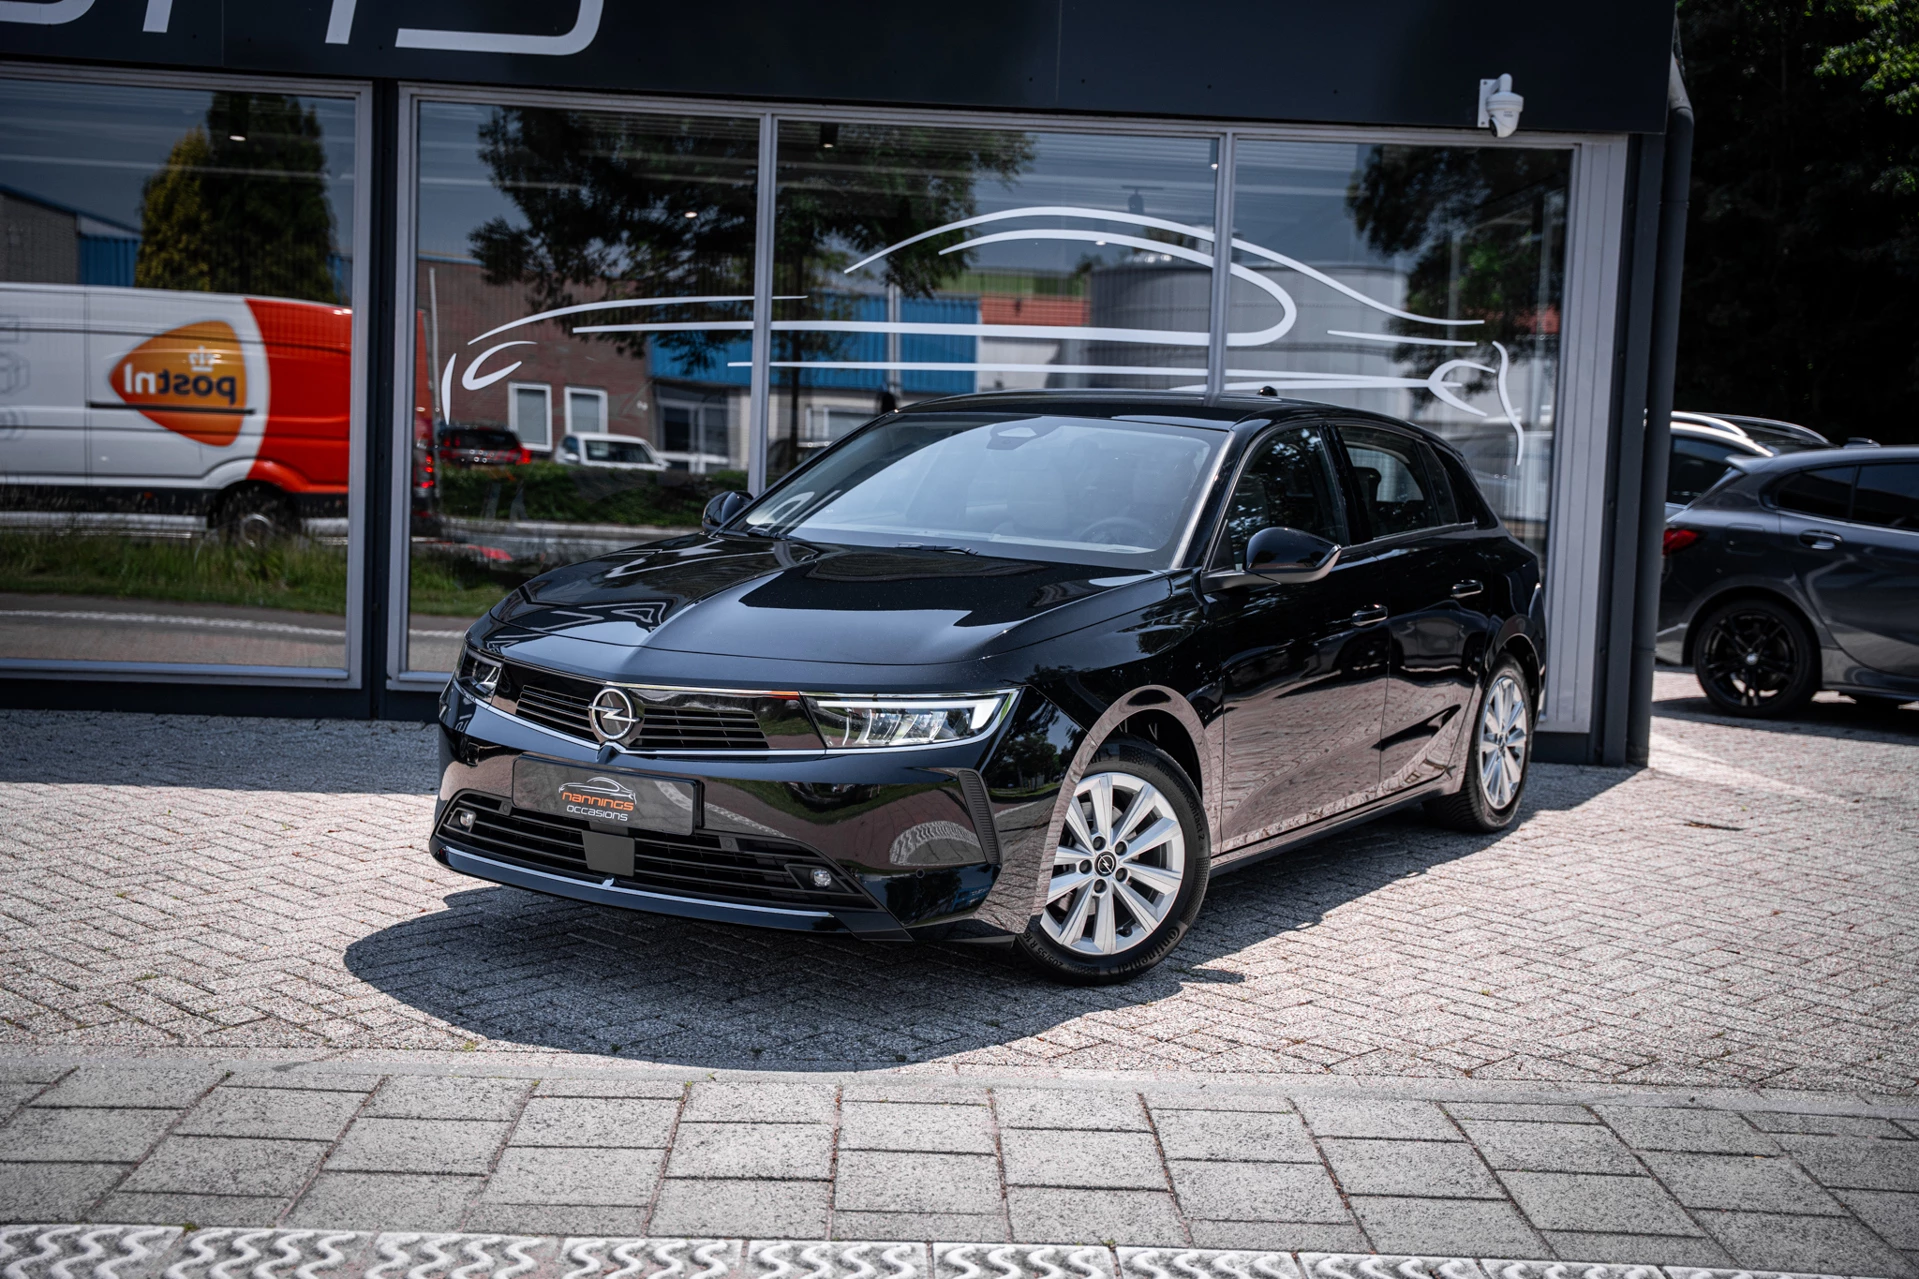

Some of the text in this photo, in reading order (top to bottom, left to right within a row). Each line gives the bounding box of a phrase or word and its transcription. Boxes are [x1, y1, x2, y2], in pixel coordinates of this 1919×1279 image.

[1029, 941, 1038, 949] R
[1117, 926, 1180, 974] Continental
[1035, 947, 1064, 968] 205/55
